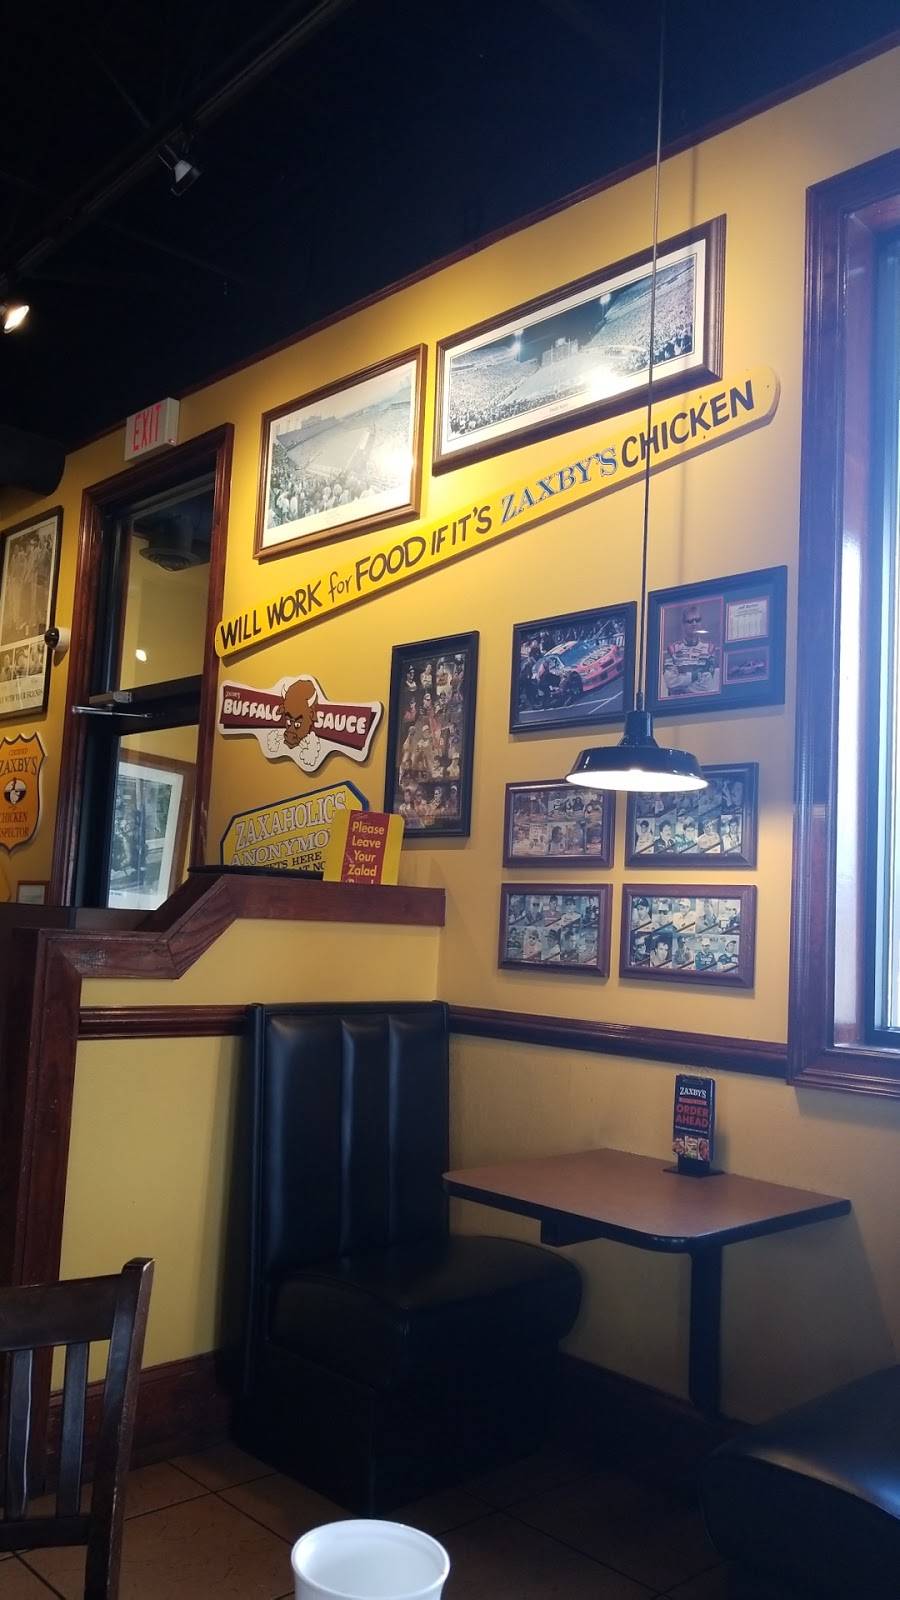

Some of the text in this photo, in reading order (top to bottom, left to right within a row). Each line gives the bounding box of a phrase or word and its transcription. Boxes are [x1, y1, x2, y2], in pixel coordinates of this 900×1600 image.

[132, 403, 161, 452] EXIT
[220, 380, 755, 650] WILL WORK for FOOD IF IT'S ZAXBY'S CHICKEN
[313, 711, 367, 735] SAUCE
[234, 790, 348, 851] ZAXAHOLICS
[352, 821, 385, 836] Please
[231, 829, 331, 867] ANONYMO
[352, 835, 381, 849] Leave
[292, 851, 322, 867] HERE
[353, 850, 376, 863] Your
[348, 863, 376, 876] Zalad
[676, 1104, 709, 1118] ORDER
[675, 1114, 708, 1128] AHEAD
